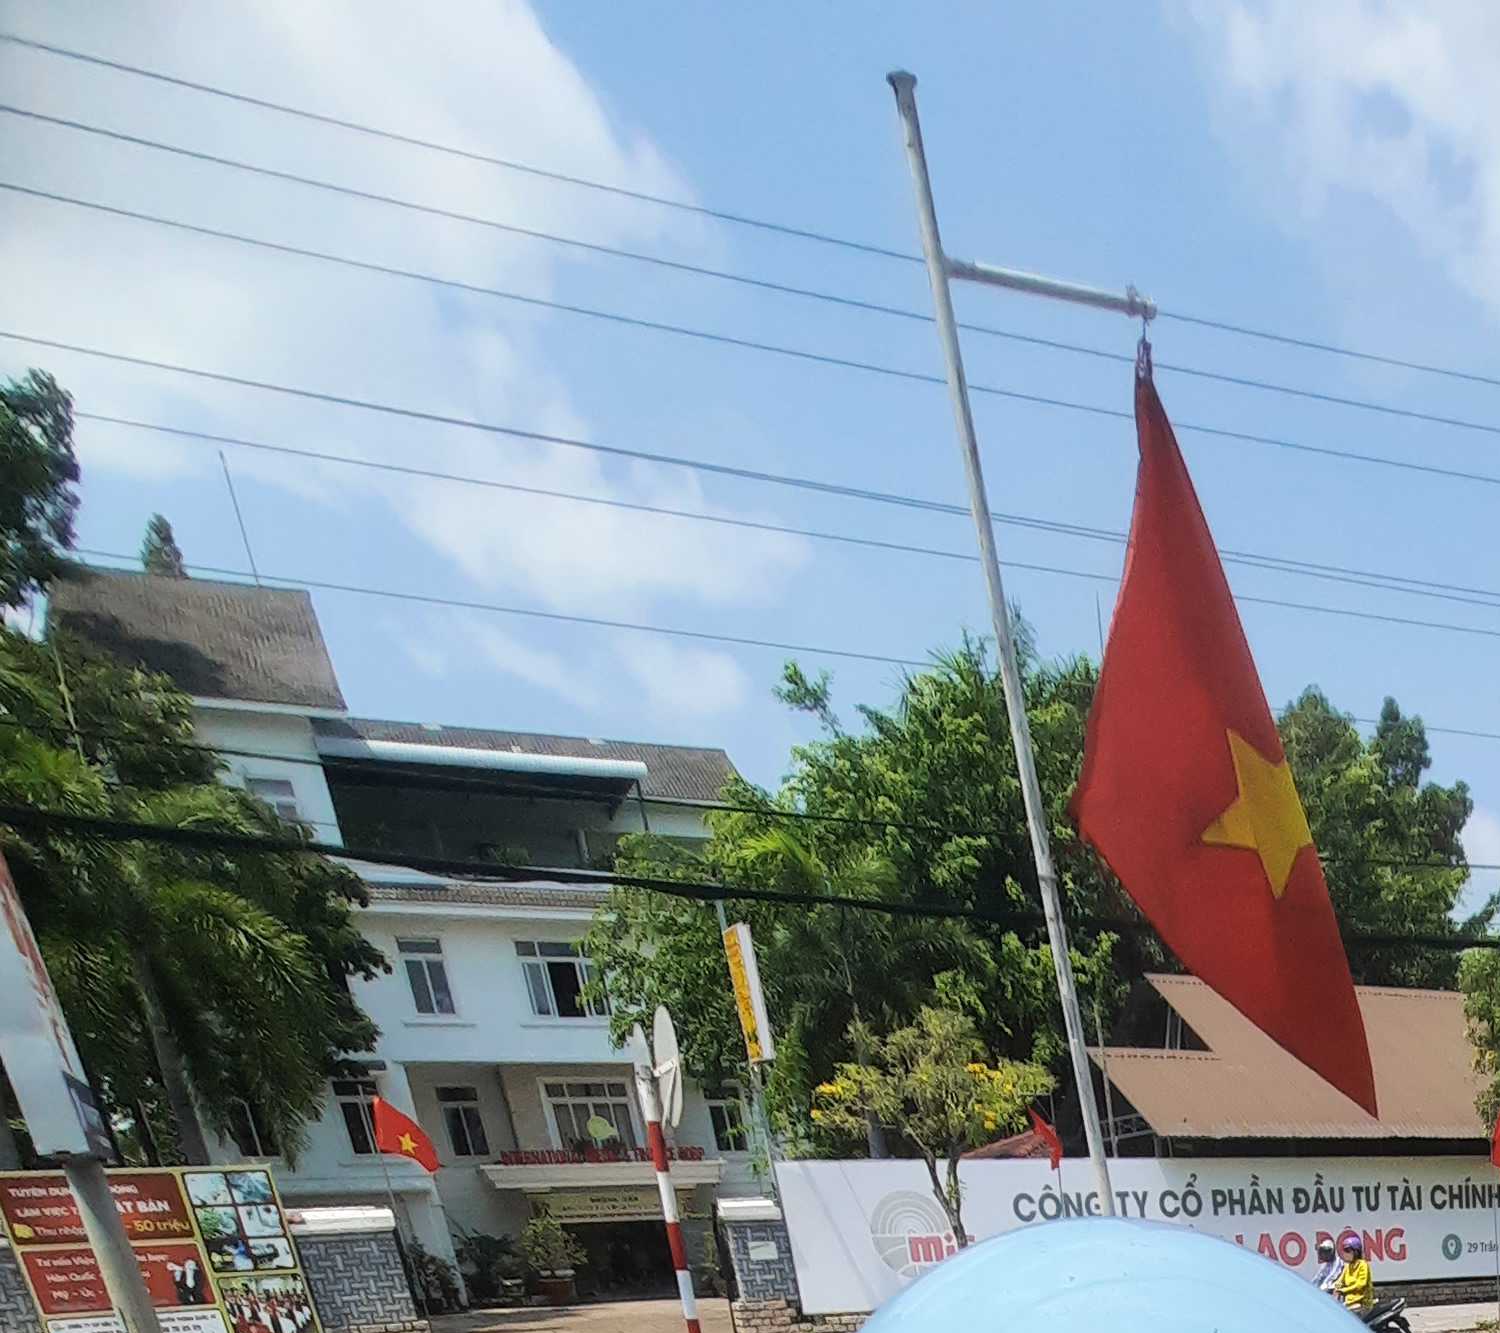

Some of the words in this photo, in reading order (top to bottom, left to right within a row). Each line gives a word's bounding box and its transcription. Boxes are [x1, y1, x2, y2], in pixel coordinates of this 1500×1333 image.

[1013, 1184, 1102, 1222] CÔNG
[1116, 1191, 1148, 1218] TY
[1159, 1173, 1203, 1218] CỔ
[1211, 1173, 1284, 1216] PHẦN
[1293, 1172, 1345, 1214] ĐẦU
[1352, 1181, 1382, 1212] TƯ
[1387, 1176, 1422, 1211] TÀI
[1467, 1241, 1478, 1253] 29
